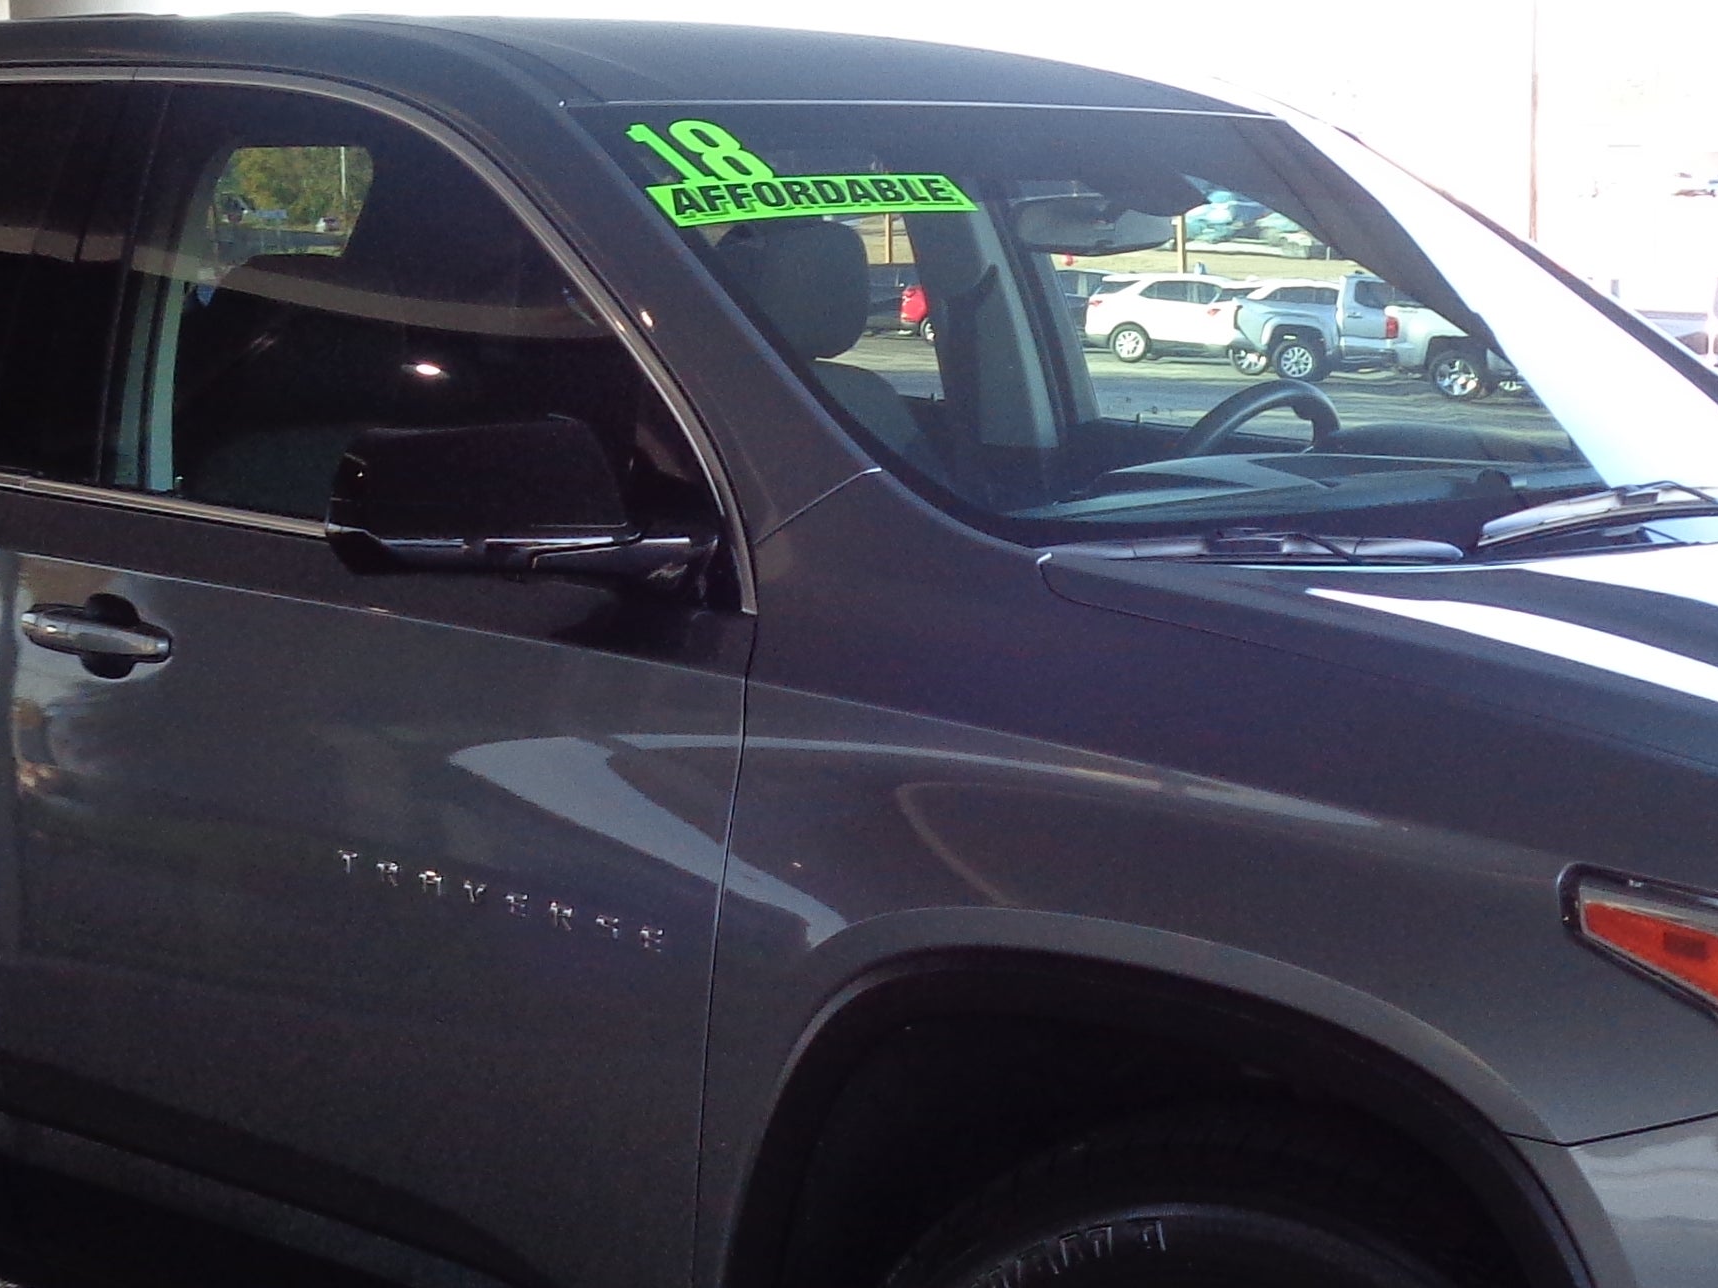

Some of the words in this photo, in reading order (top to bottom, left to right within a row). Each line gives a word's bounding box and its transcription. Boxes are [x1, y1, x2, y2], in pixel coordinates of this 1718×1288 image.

[626, 119, 773, 181] 18
[671, 178, 959, 218] AFFORDABLE
[337, 847, 667, 954] TRAVERSE
